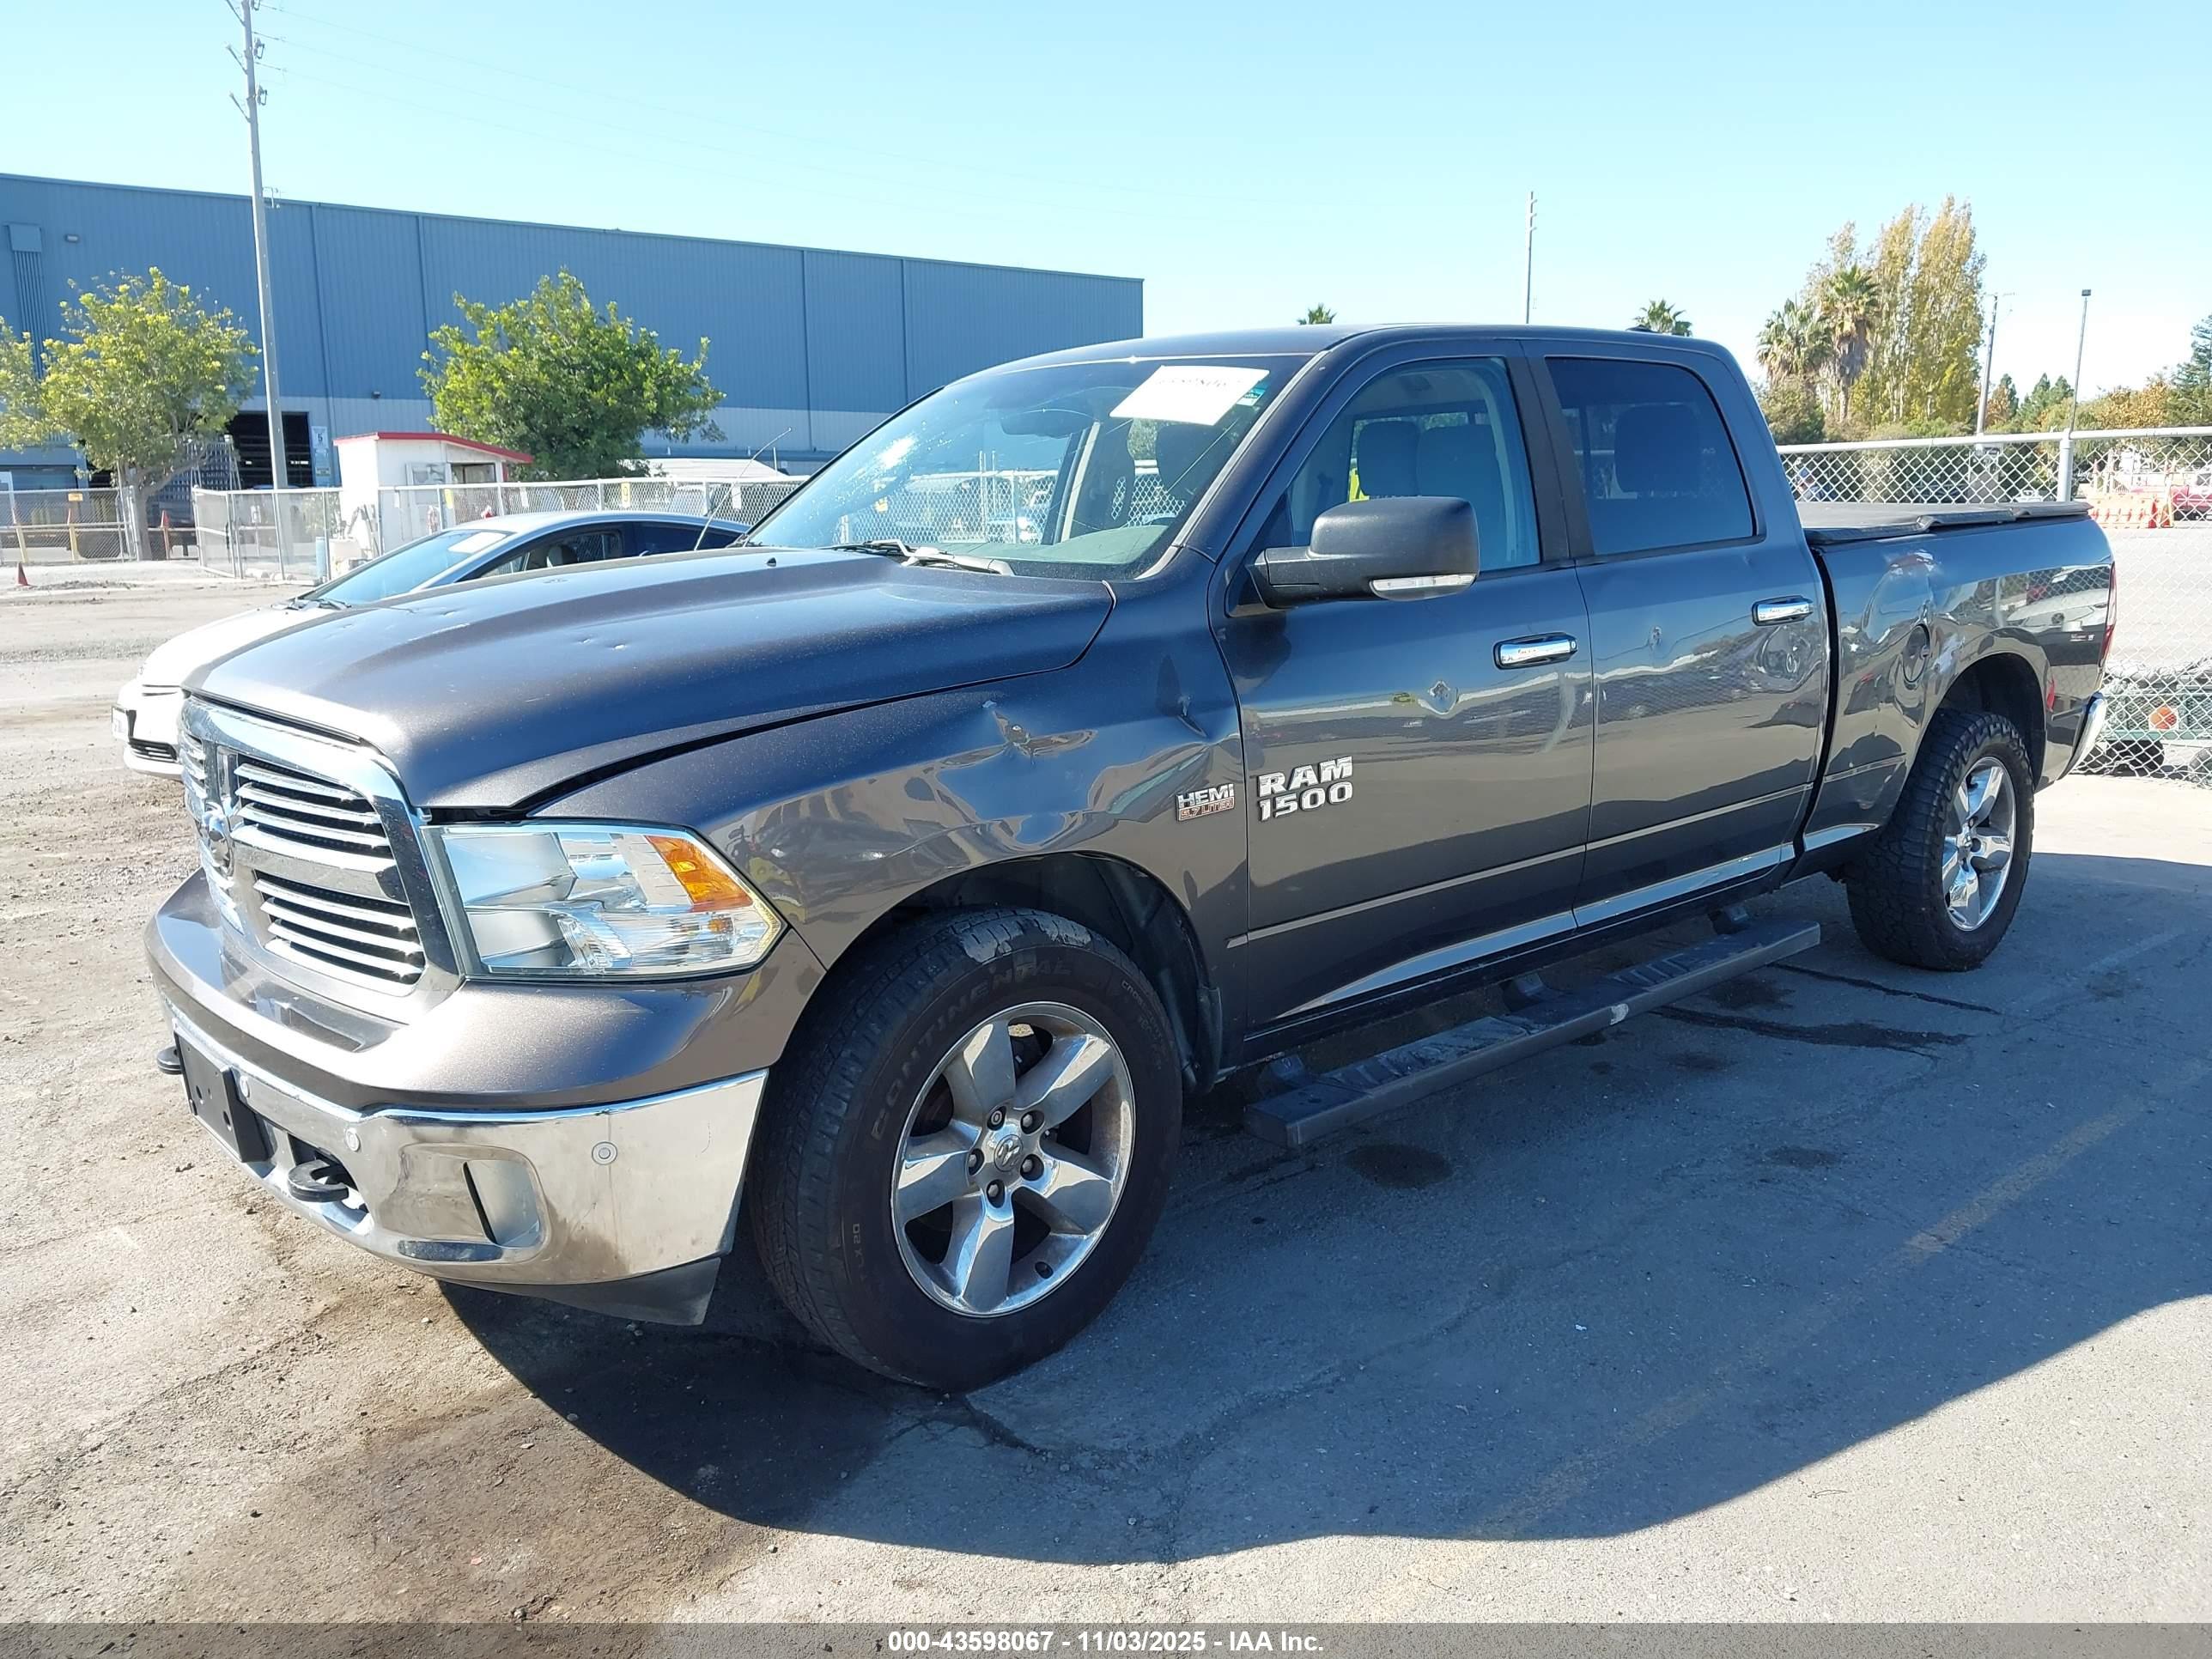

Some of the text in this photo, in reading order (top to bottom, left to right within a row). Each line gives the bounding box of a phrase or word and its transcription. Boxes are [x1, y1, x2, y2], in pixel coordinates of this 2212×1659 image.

[1258, 755, 1353, 799] RAM
[1176, 783, 1235, 808] HEMI
[1180, 797, 1234, 820] 5.7 LITER
[1258, 781, 1354, 822] 1500
